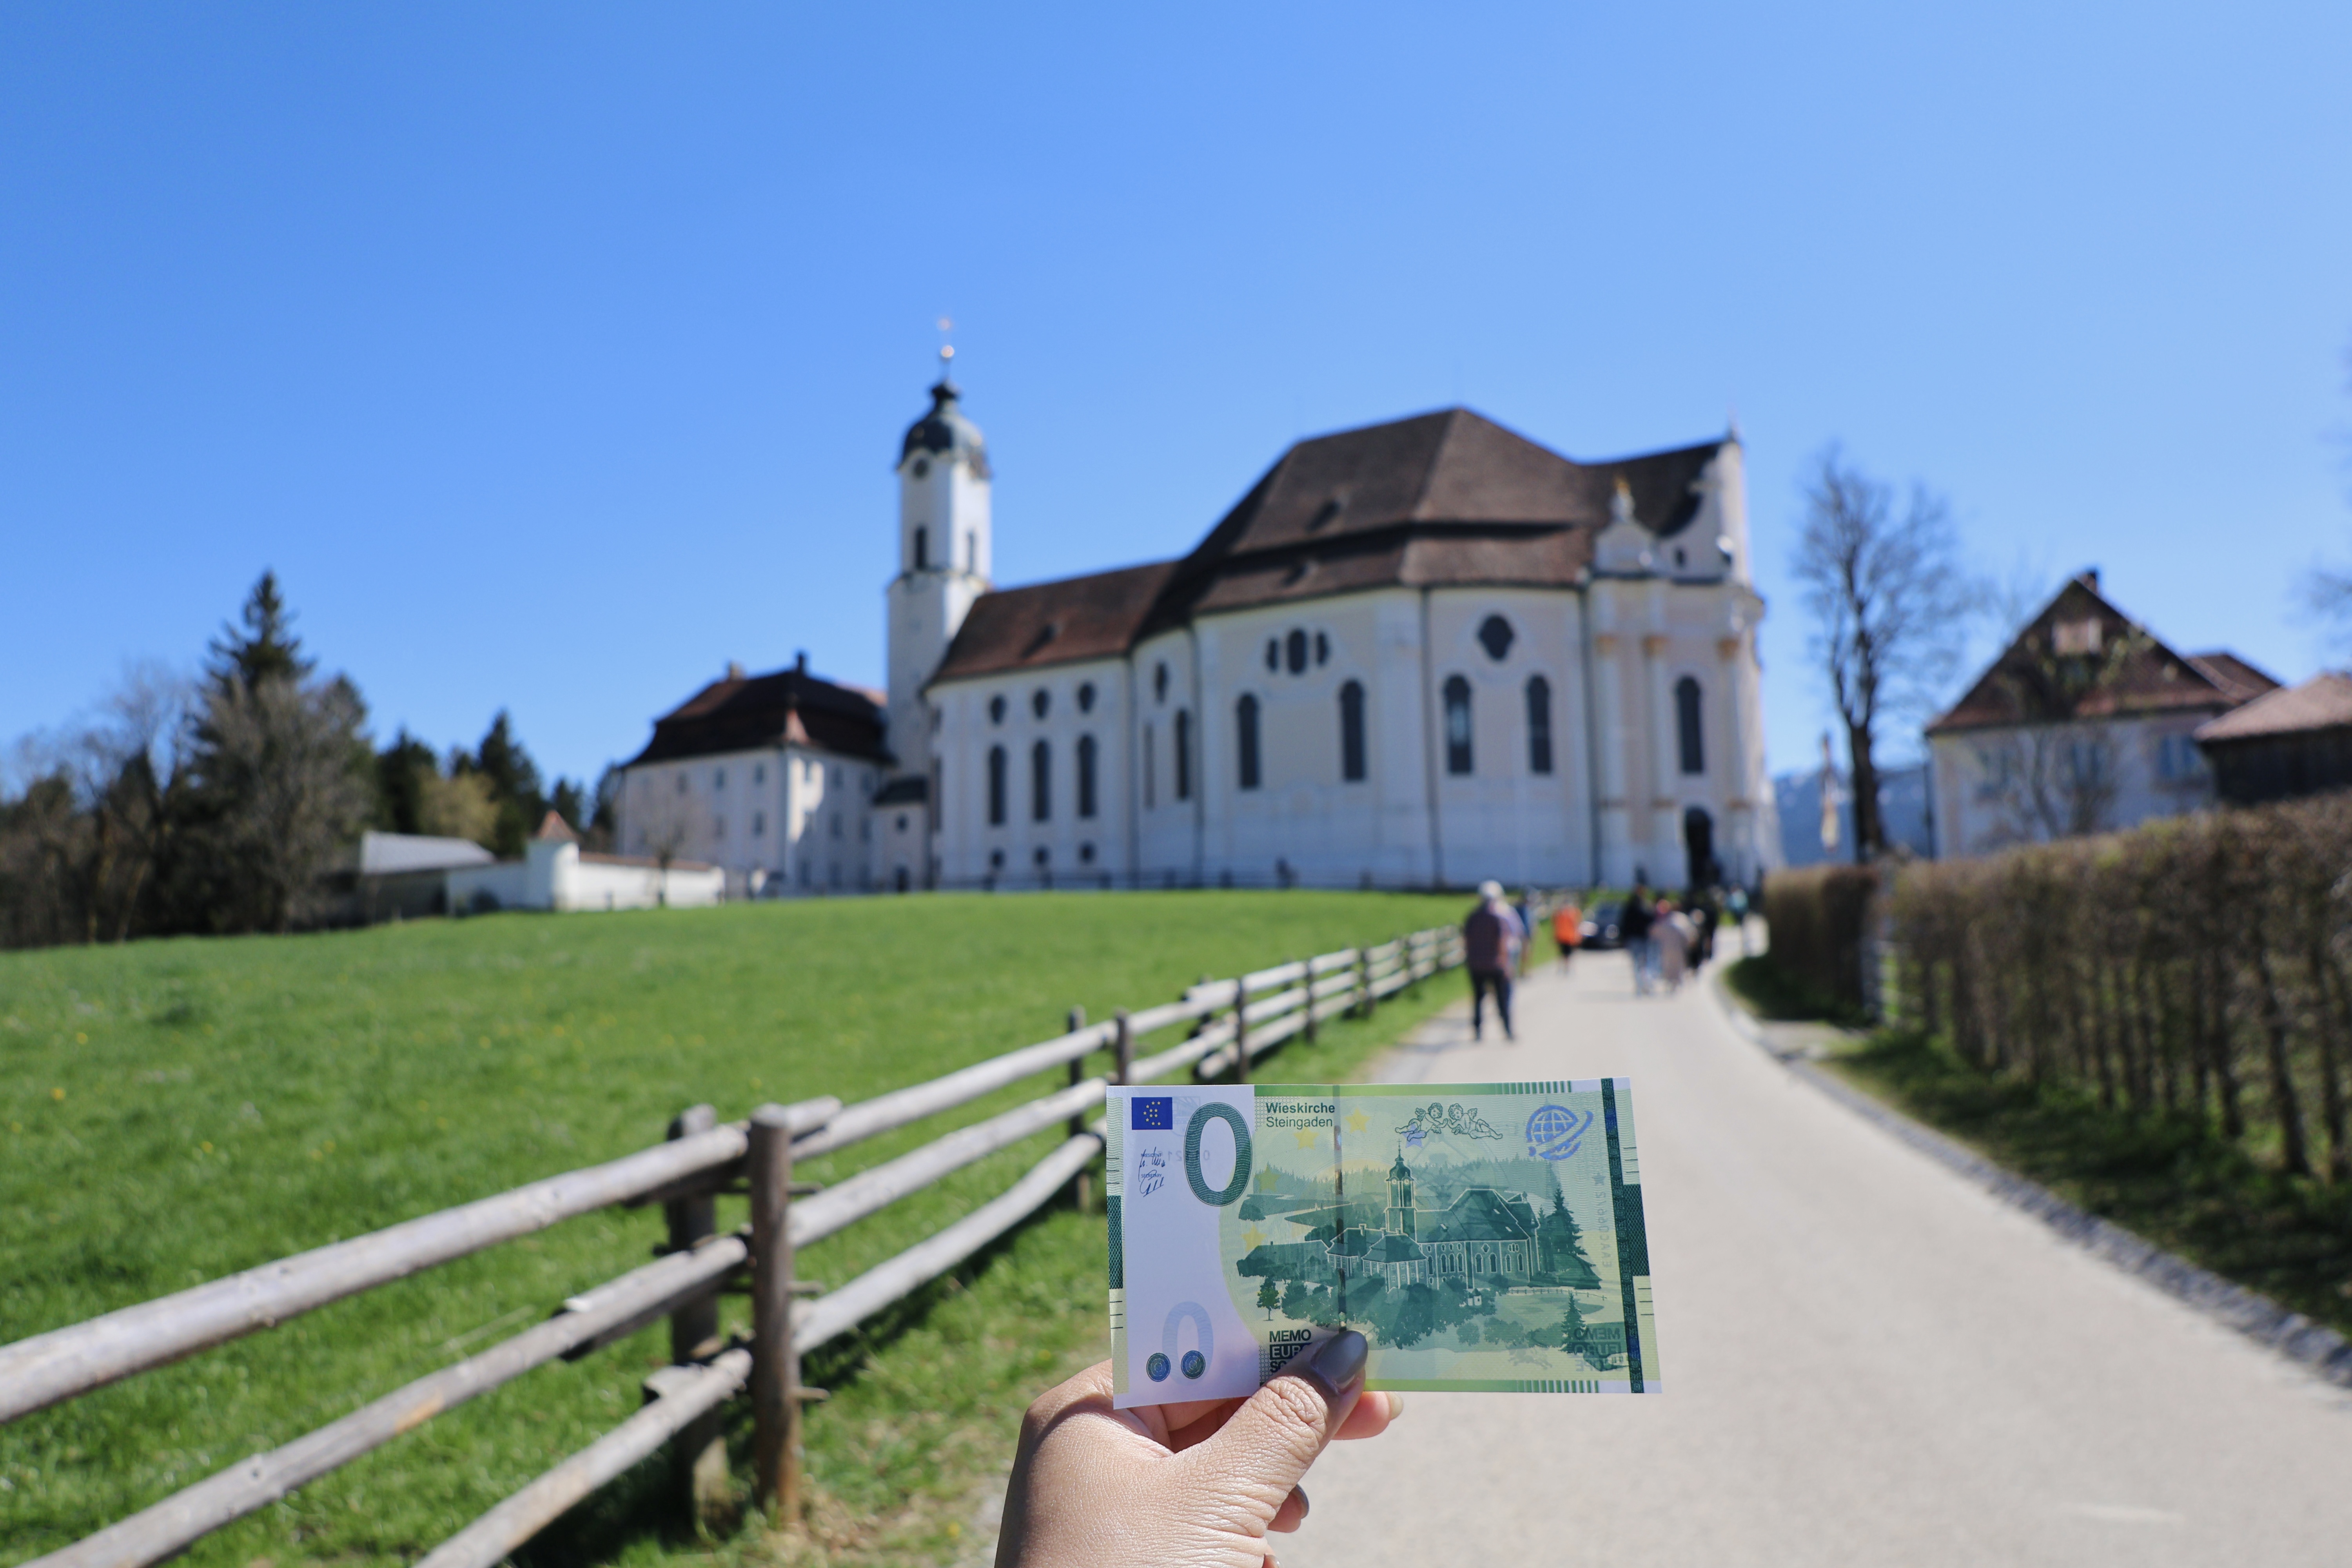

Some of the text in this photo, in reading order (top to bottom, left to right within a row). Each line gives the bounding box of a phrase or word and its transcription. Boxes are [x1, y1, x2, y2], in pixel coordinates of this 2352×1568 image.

[1266, 1102, 1335, 1113] Wieskirche
[1266, 1116, 1332, 1130] Steingaden
[1184, 1102, 1252, 1207] 0
[1269, 1329, 1311, 1342] MEMO
